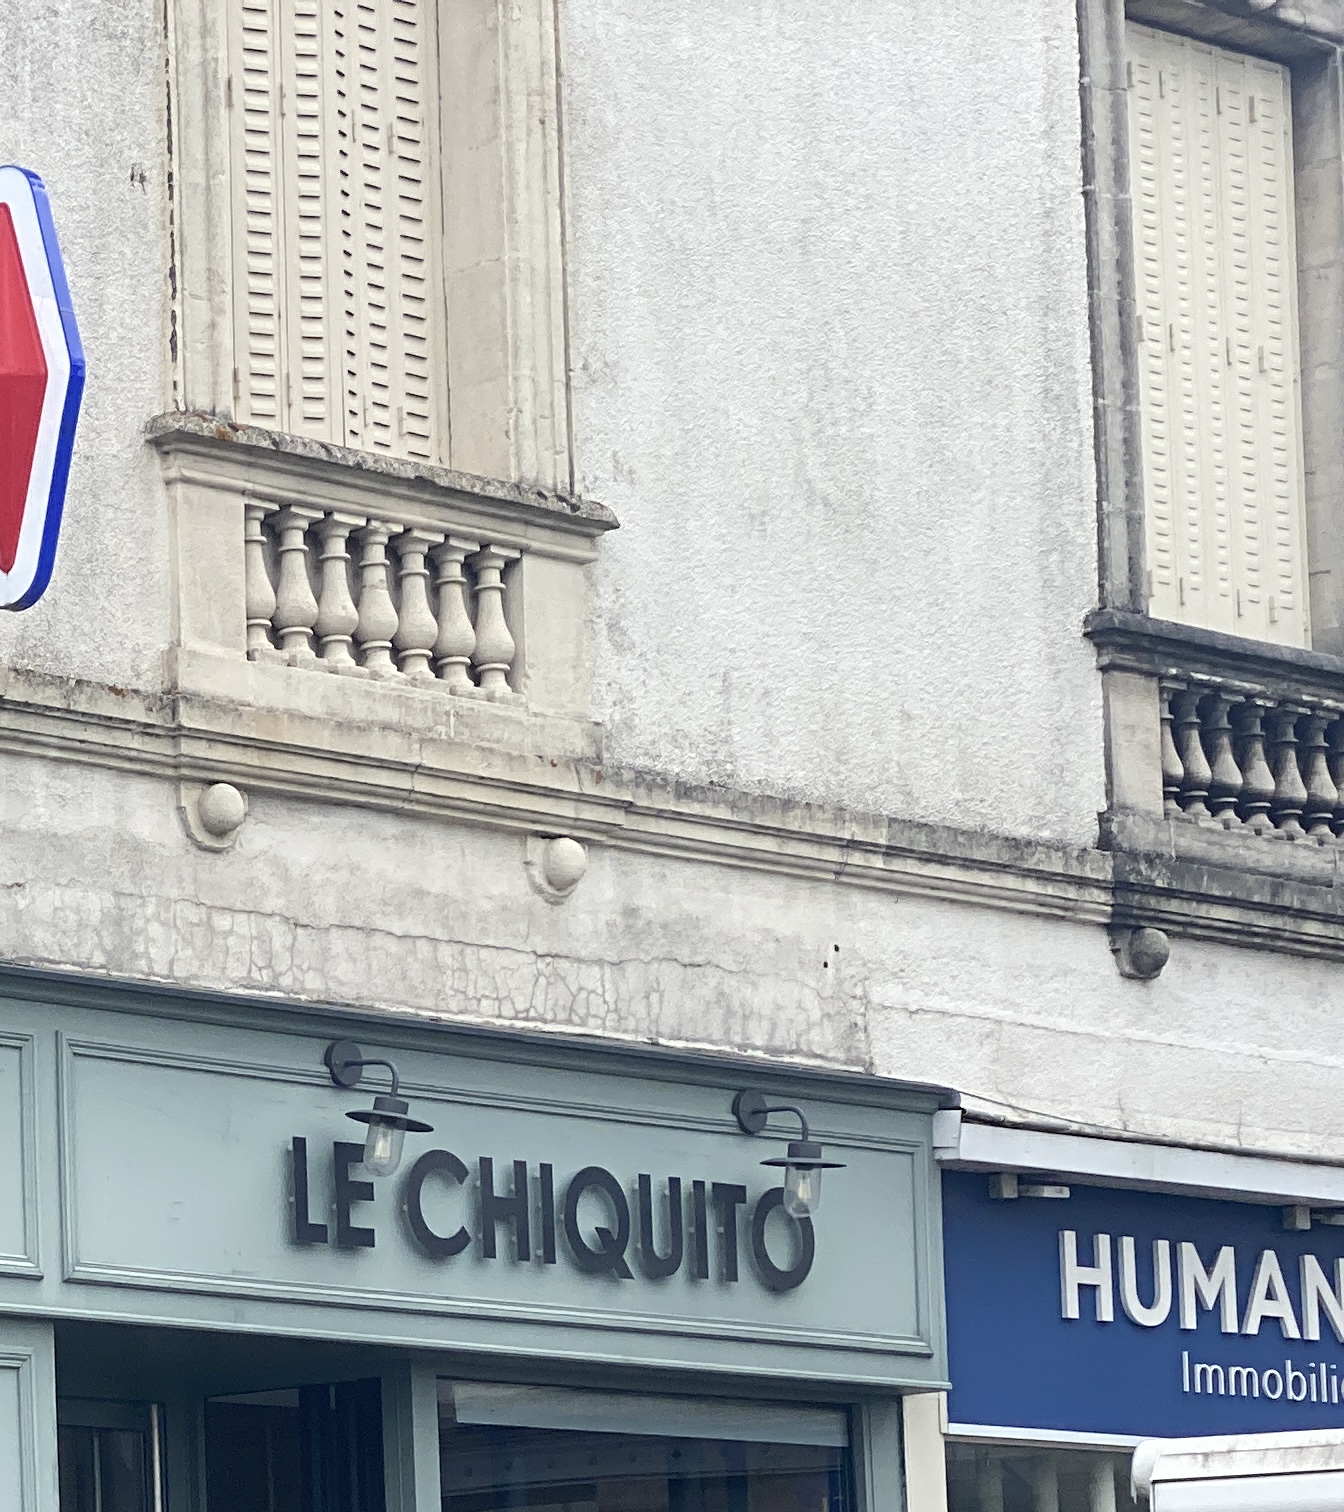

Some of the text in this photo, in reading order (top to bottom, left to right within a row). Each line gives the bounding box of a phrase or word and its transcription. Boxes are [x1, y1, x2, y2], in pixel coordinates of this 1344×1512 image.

[291, 1135, 815, 1292] LE CHIQUITO
[1058, 1229, 1344, 1343] HUMAN
